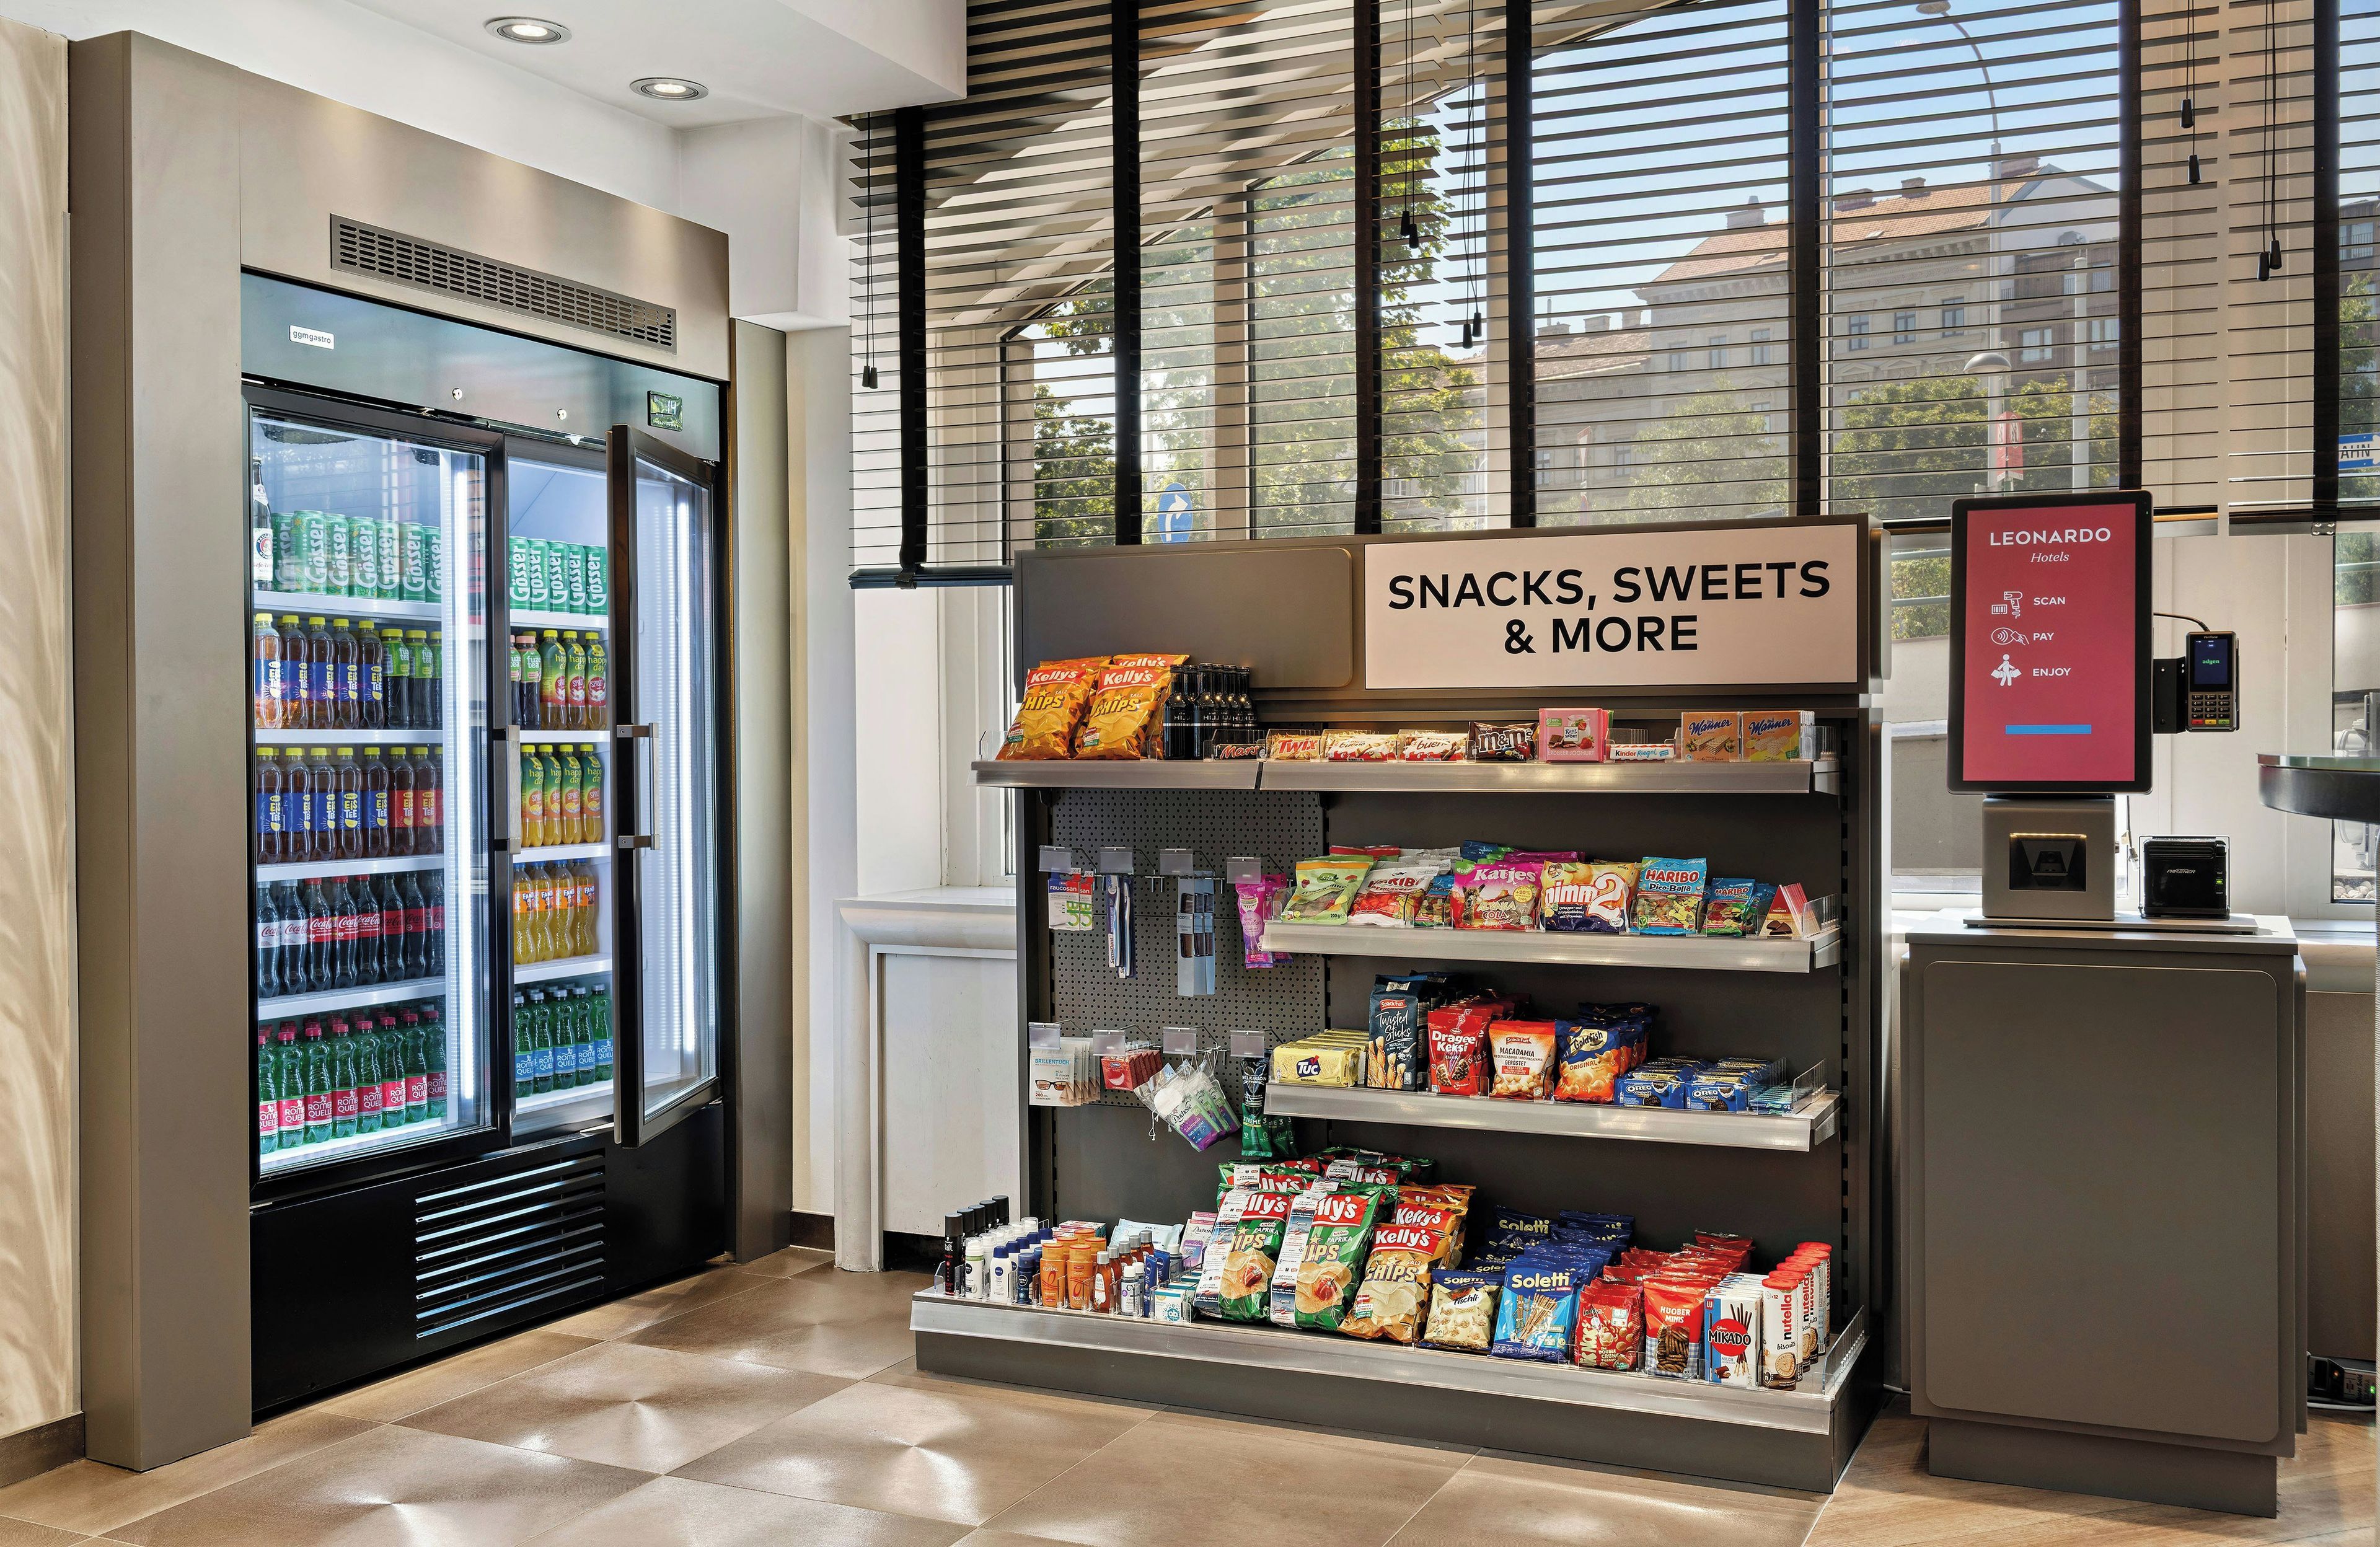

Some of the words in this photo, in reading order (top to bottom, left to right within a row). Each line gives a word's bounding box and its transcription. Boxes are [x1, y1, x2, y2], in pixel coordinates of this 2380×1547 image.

[293, 331, 331, 343] ggmgastro
[1990, 527, 2111, 546] LEONARDO
[304, 521, 327, 583] Gösser
[328, 524, 348, 586] Gösser
[355, 527, 377, 588] Gösser
[2030, 552, 2069, 563] Hotels
[403, 532, 425, 591] Gösser
[509, 545, 530, 601] Gösser
[586, 554, 607, 607] Gösser
[1388, 568, 1596, 611] SNACKS,
[1612, 560, 1830, 602] SWEETS
[2034, 596, 2066, 606] SCAN
[1504, 619, 1536, 654] &
[1553, 615, 1698, 653] MORE
[2033, 632, 2055, 641] PAY
[1104, 670, 1153, 685] Kelly's
[2032, 668, 2071, 677] ENJOY
[1689, 719, 1732, 736] Manner
[1748, 718, 1793, 735] Manner
[1277, 738, 1318, 754] Twix
[1339, 739, 1365, 749] bueno
[1417, 739, 1450, 751] bueno
[1220, 745, 1259, 759] Mars
[1637, 749, 1657, 758] Riegel
[1474, 867, 1536, 883] Katjes
[1646, 870, 1699, 883] HARIBO
[1649, 883, 1691, 892] Pico-Balla
[1476, 901, 1516, 912] ALPAKA
[1482, 910, 1510, 919] COLA
[1375, 1010, 1409, 1028] Twisted
[1385, 1025, 1412, 1041] Sticks
[1432, 1030, 1476, 1044] Dragee
[1574, 1031, 1603, 1049] Goldfish
[1437, 1042, 1468, 1052] Keksi
[1500, 1047, 1535, 1057] MACADAMIA
[579, 1056, 595, 1064] QUELL
[597, 1051, 613, 1060] QUELL
[517, 1067, 534, 1075] QUELL
[1569, 1060, 1597, 1070] ORIGINAL
[428, 1085, 447, 1094] QUELL
[1692, 1090, 1718, 1098] OREO
[364, 1100, 382, 1108] QUELL
[286, 1114, 304, 1122] QUELL
[1243, 1116, 1261, 1124] XTREME
[1243, 1194, 1288, 1215] lly's
[1315, 1196, 1358, 1221] lly's
[1499, 1219, 1549, 1234] Soletti
[1375, 1229, 1430, 1247] Kelly's
[1364, 1264, 1417, 1283] CHIPS
[1511, 1272, 1571, 1289] Soletti
[1660, 1307, 1690, 1316] HUOBER
[1781, 1294, 1792, 1340] nutella
[1708, 1331, 1751, 1346] MIKADO
[1777, 1341, 1796, 1351] biscuits
